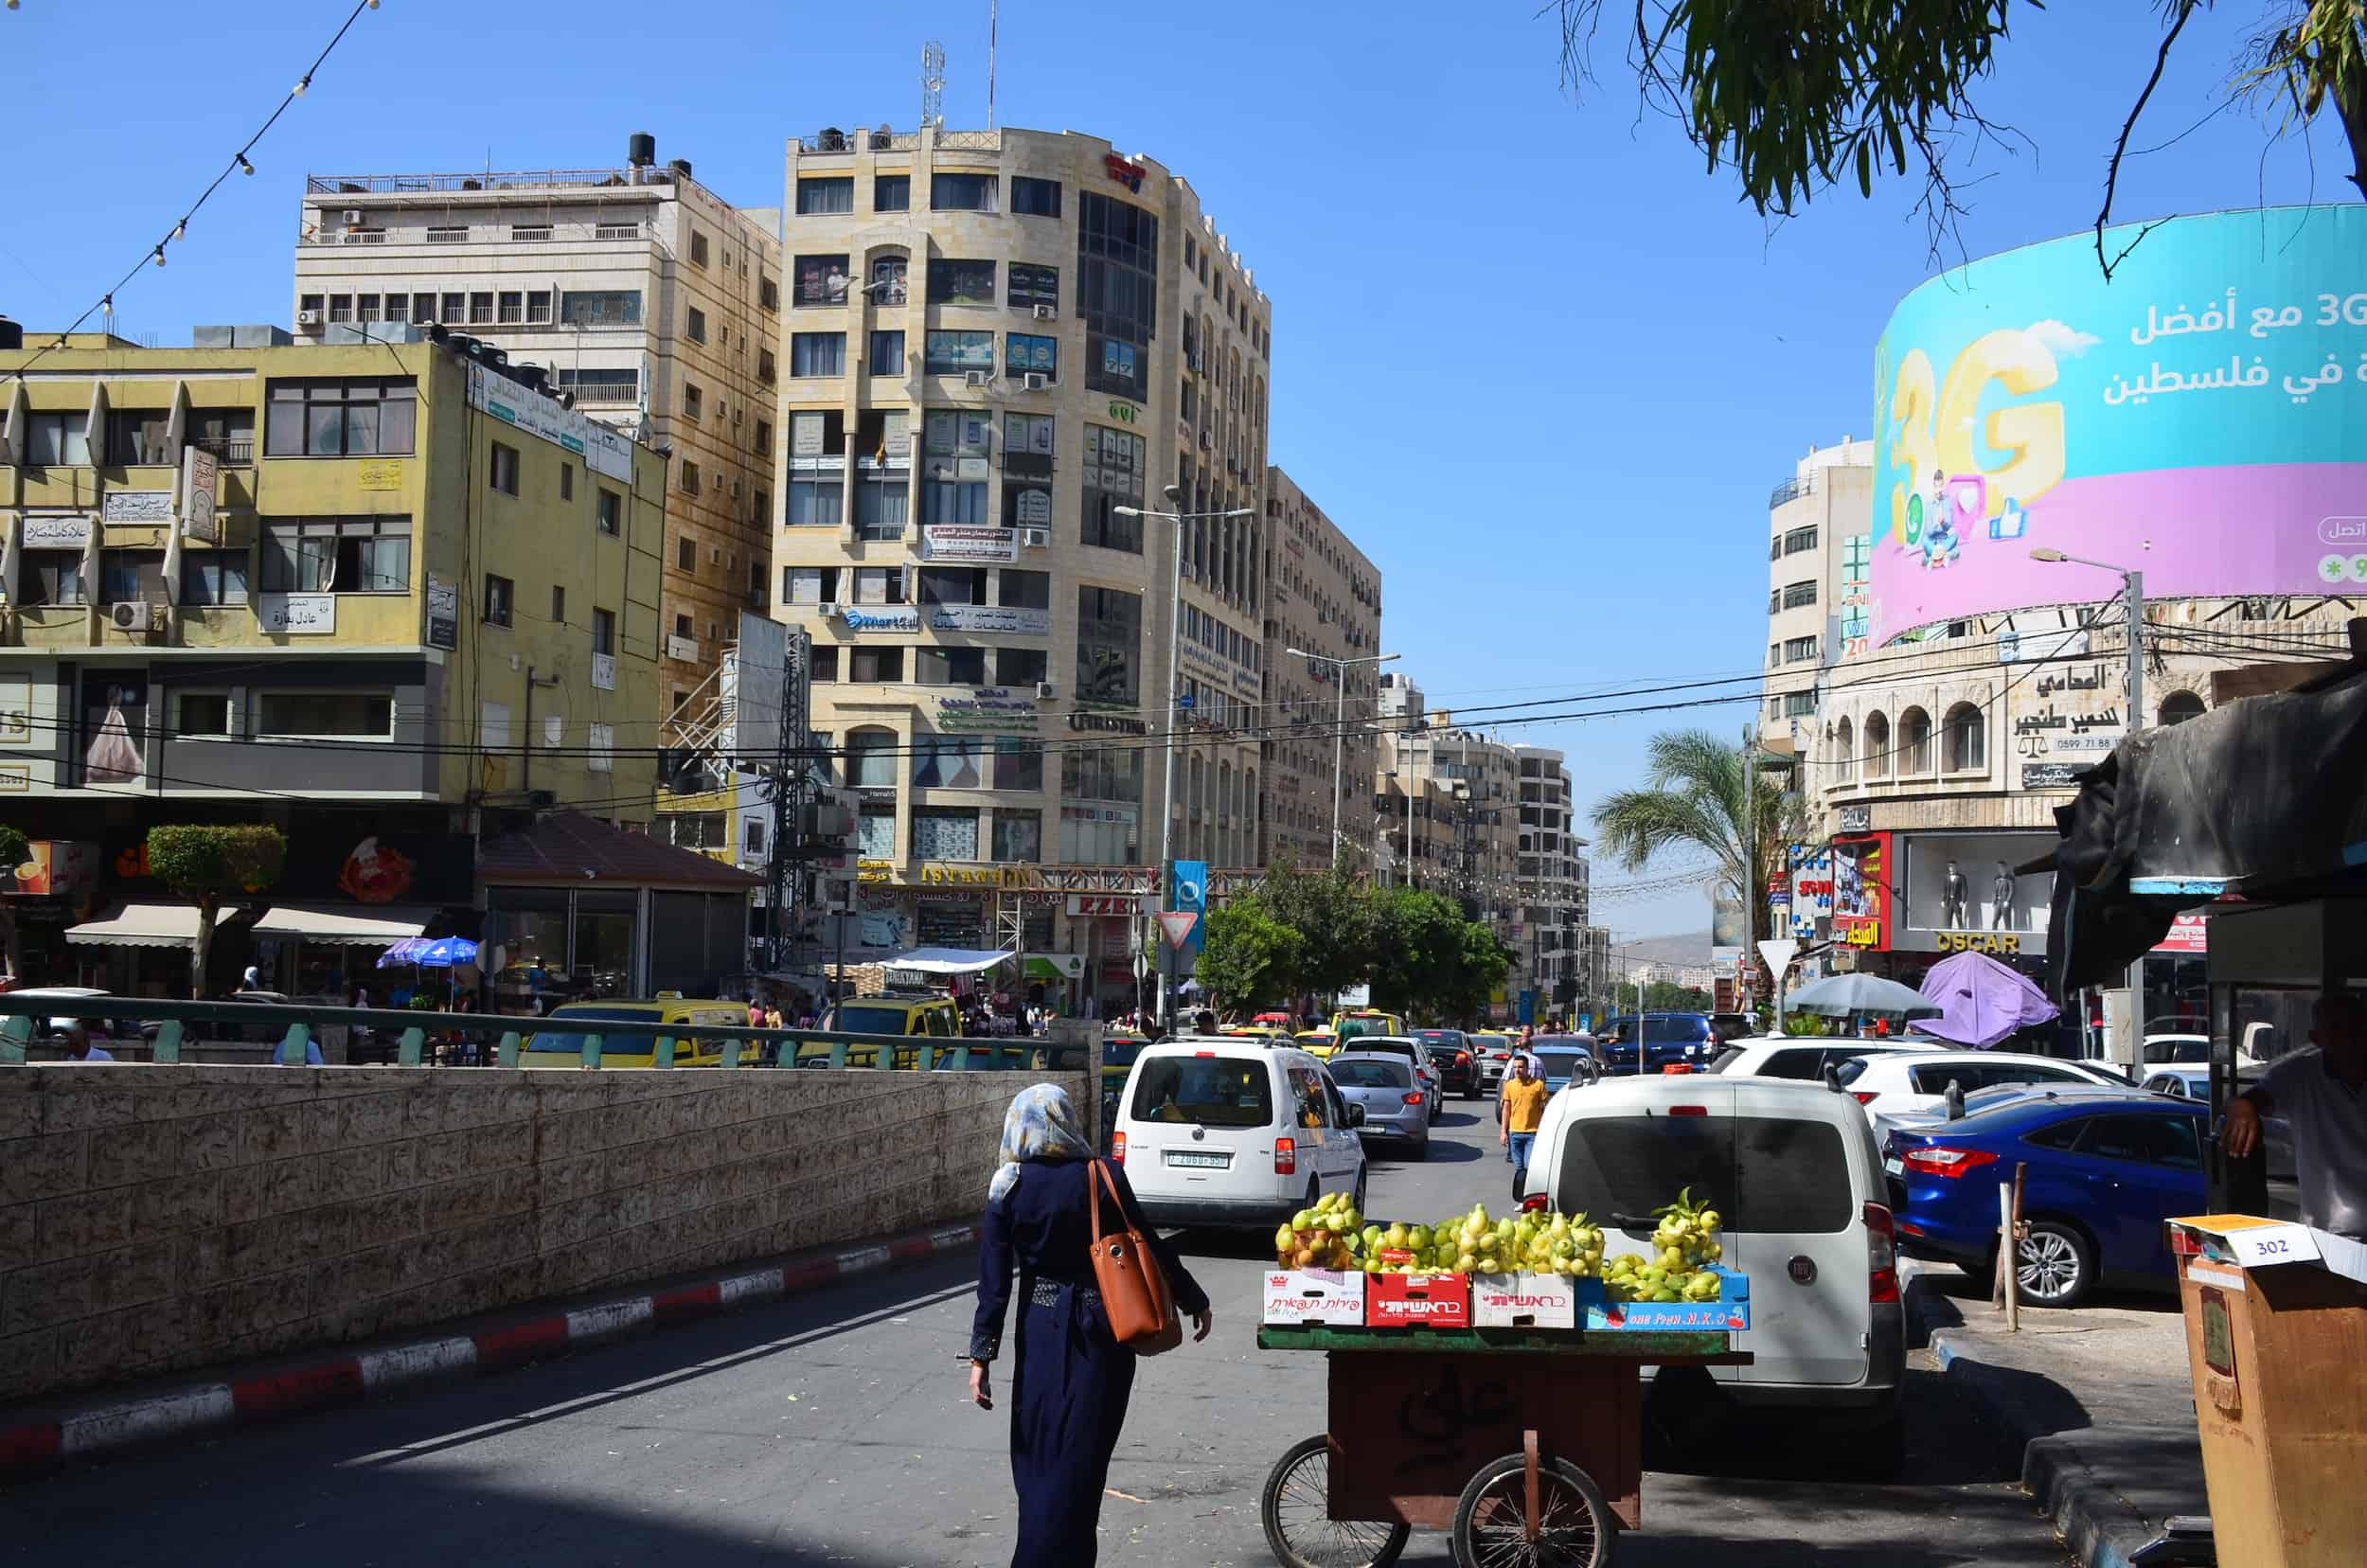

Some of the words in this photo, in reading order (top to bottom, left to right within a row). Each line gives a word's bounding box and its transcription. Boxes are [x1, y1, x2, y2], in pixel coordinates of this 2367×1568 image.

[2130, 288, 2236, 346] أفضل
[2250, 305, 2304, 338] مع
[2103, 352, 2269, 405] فلسطين
[2283, 353, 2343, 403] في
[2037, 664, 2106, 698] المحامي
[2071, 706, 2121, 735] سمير
[2057, 739, 2081, 749] 0599
[2085, 739, 2094, 748] 71
[1938, 932, 2018, 953] OSCAR
[2256, 1239, 2289, 1256] 302
